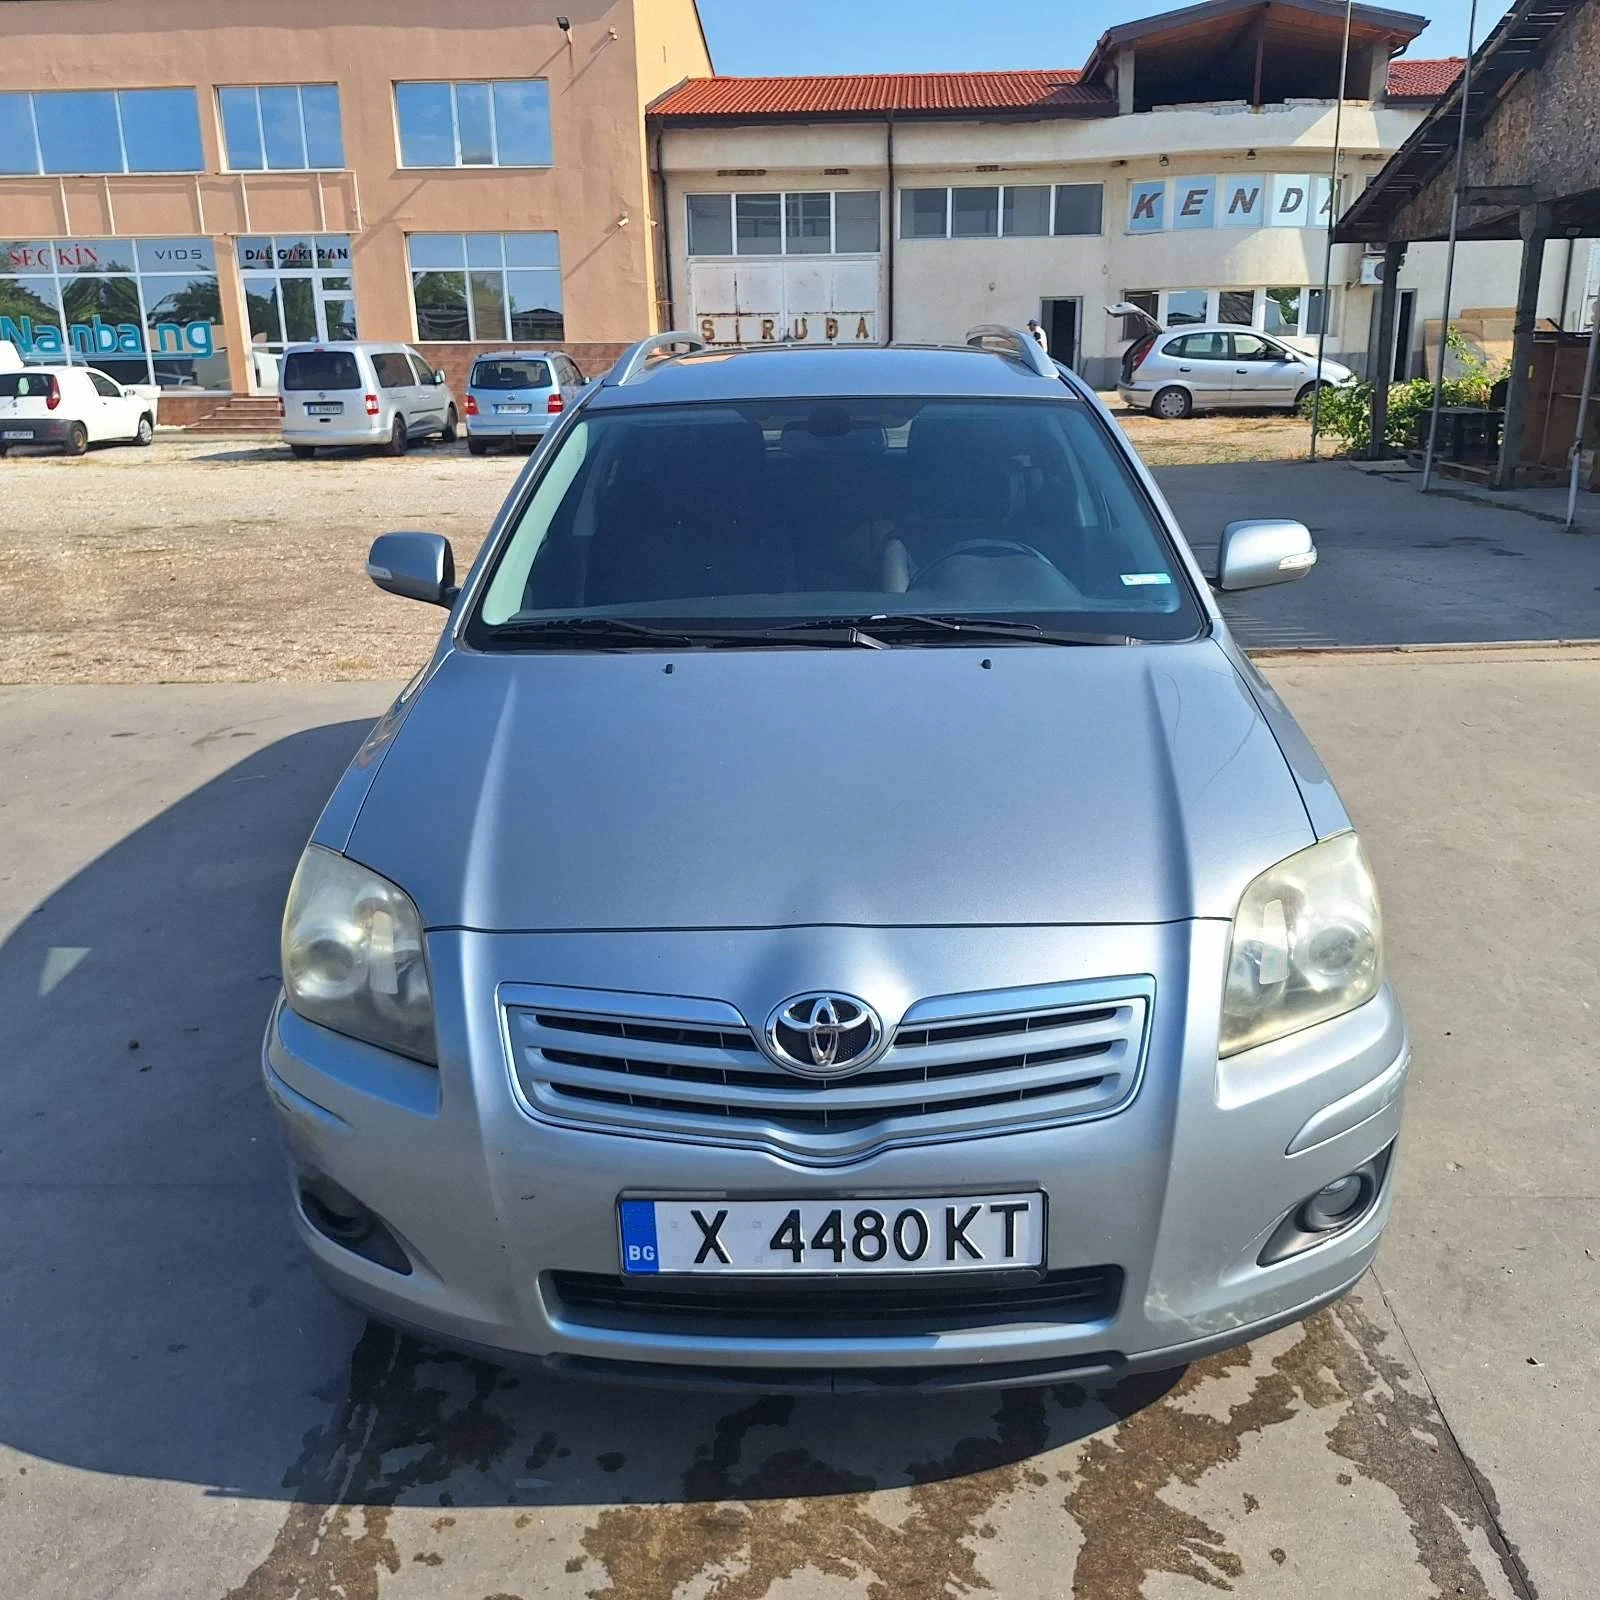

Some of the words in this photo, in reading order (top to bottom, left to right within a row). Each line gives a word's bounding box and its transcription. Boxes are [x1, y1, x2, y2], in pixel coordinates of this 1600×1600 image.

[10, 244, 98, 270] SEÇKİN
[690, 1209, 730, 1263] X
[769, 1207, 929, 1263] 4480
[945, 1203, 1030, 1261] KT
[628, 1244, 656, 1262] BG
